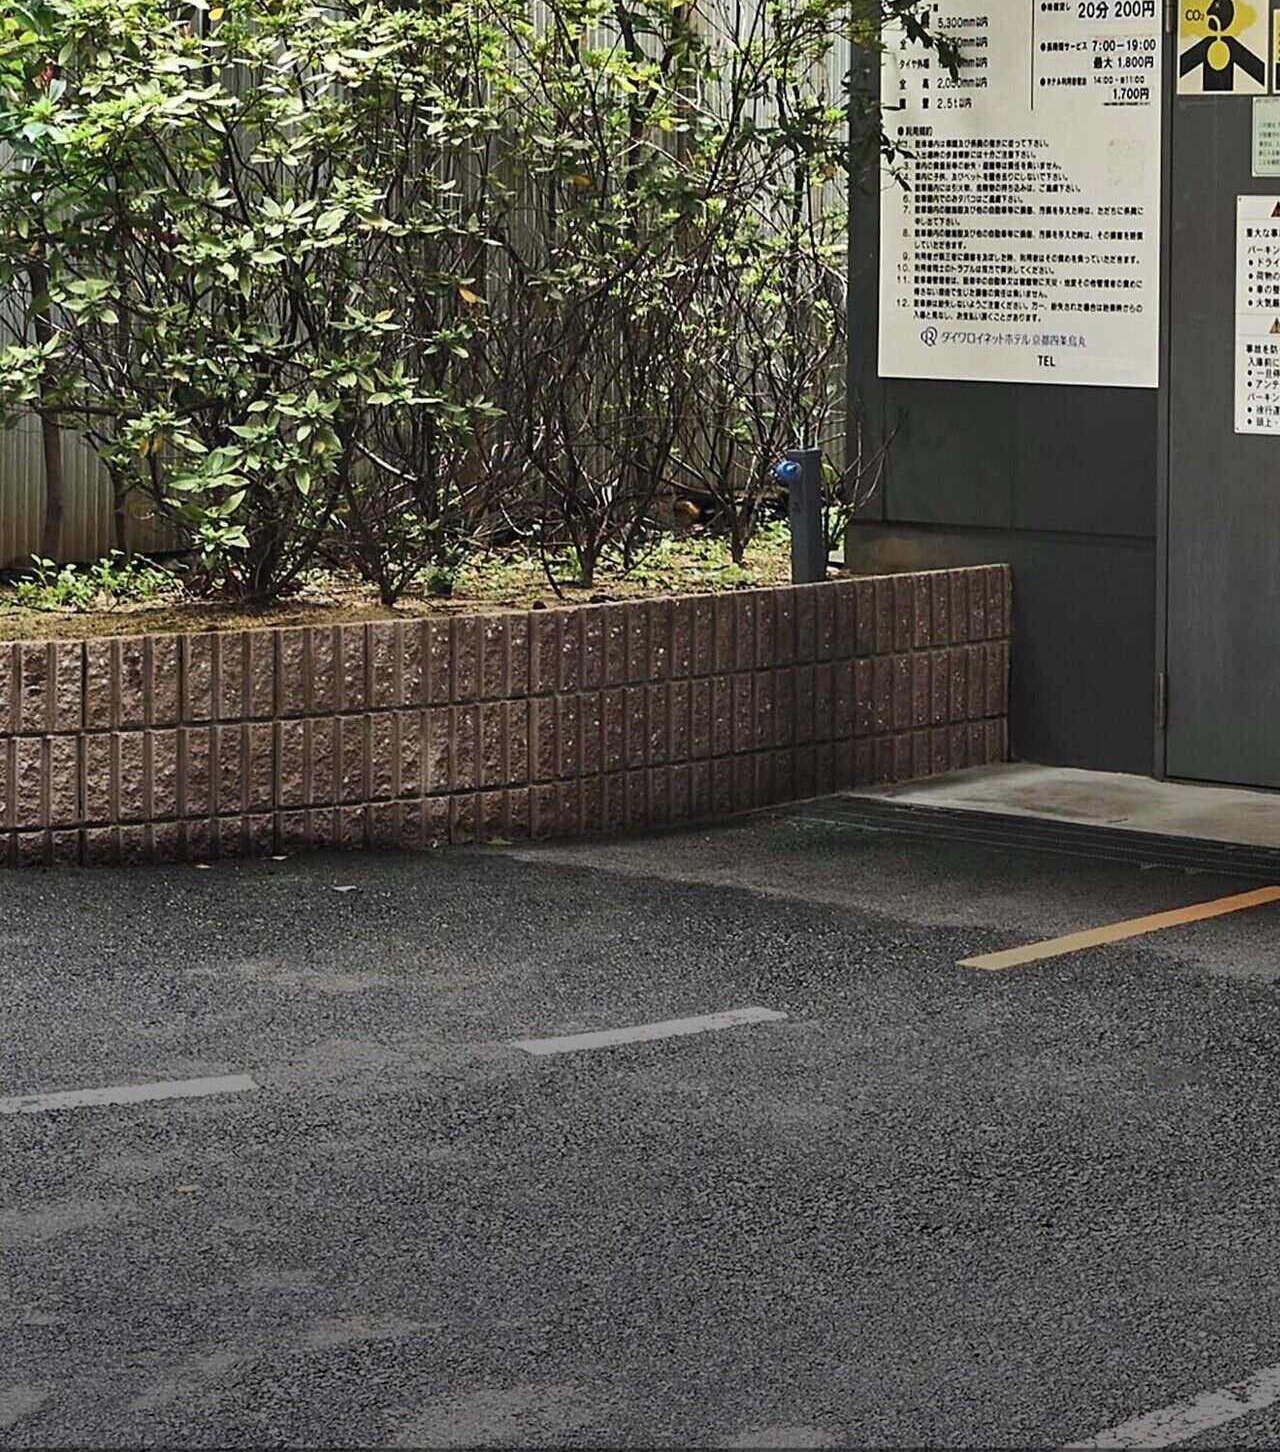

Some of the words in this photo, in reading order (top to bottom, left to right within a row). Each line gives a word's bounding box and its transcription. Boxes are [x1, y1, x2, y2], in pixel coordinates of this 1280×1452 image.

[1078, 0, 1110, 19] 20分
[1114, 0, 1155, 18] 200円
[940, 331, 1086, 348] ダイワロイネットホテル京都四条烏丸
[1037, 355, 1056, 367] TEL
